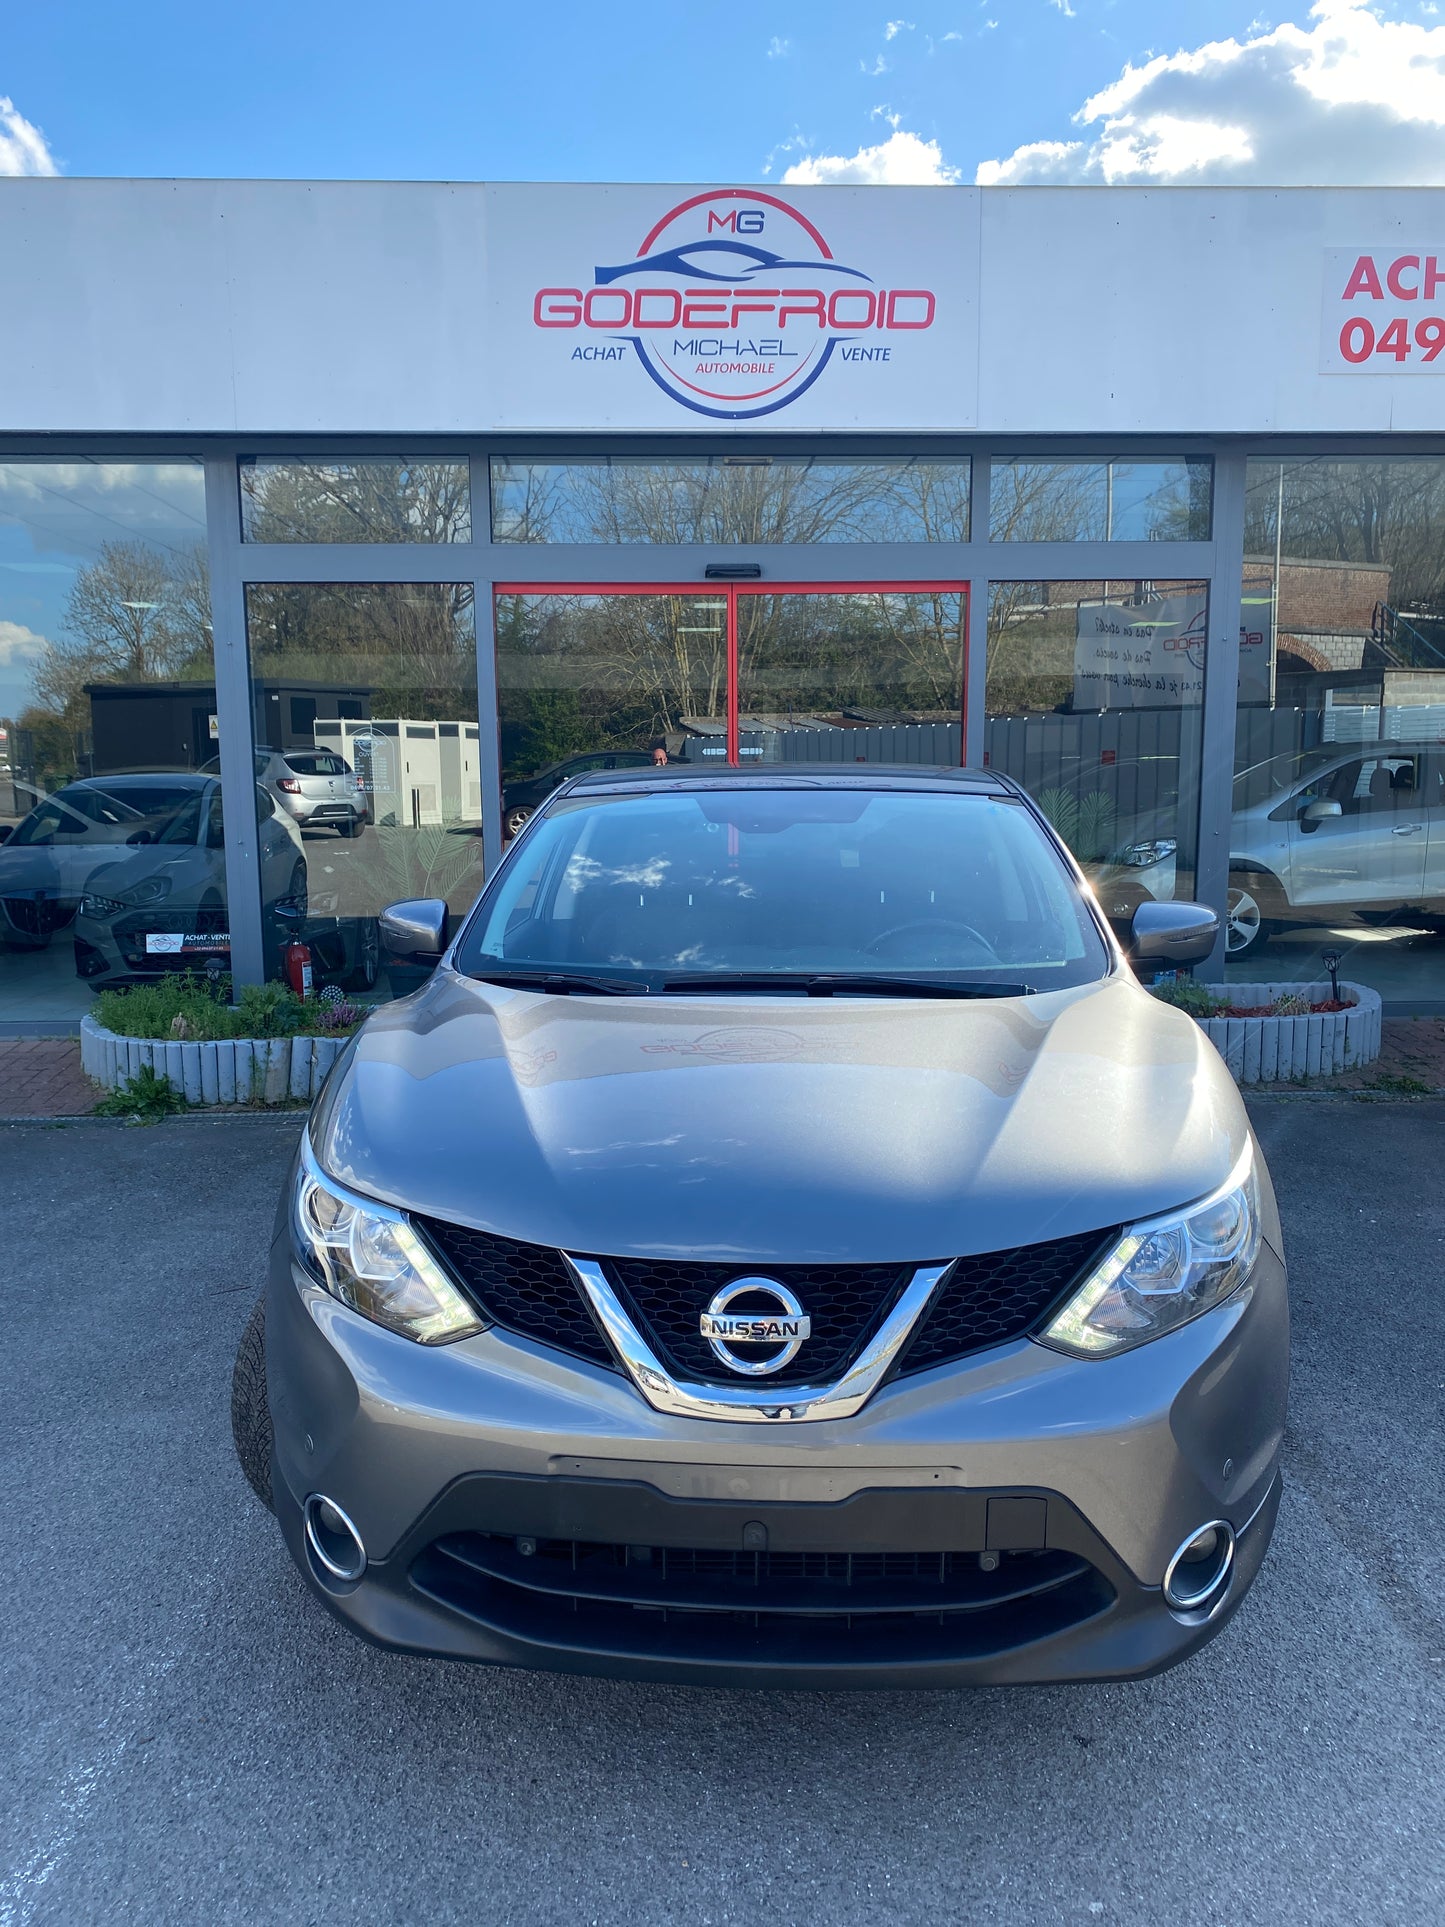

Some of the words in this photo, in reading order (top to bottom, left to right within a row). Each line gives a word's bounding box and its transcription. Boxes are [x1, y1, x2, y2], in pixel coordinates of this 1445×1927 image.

[707, 210, 765, 234] MG
[533, 288, 936, 329] GODEFROID
[673, 339, 798, 356] MICHAEL
[1339, 316, 1445, 363] 049
[571, 346, 627, 361] ACHAT
[841, 347, 891, 361] VENTE
[695, 362, 775, 374] AUTOMOBILE
[711, 1320, 798, 1336] NISSAN
